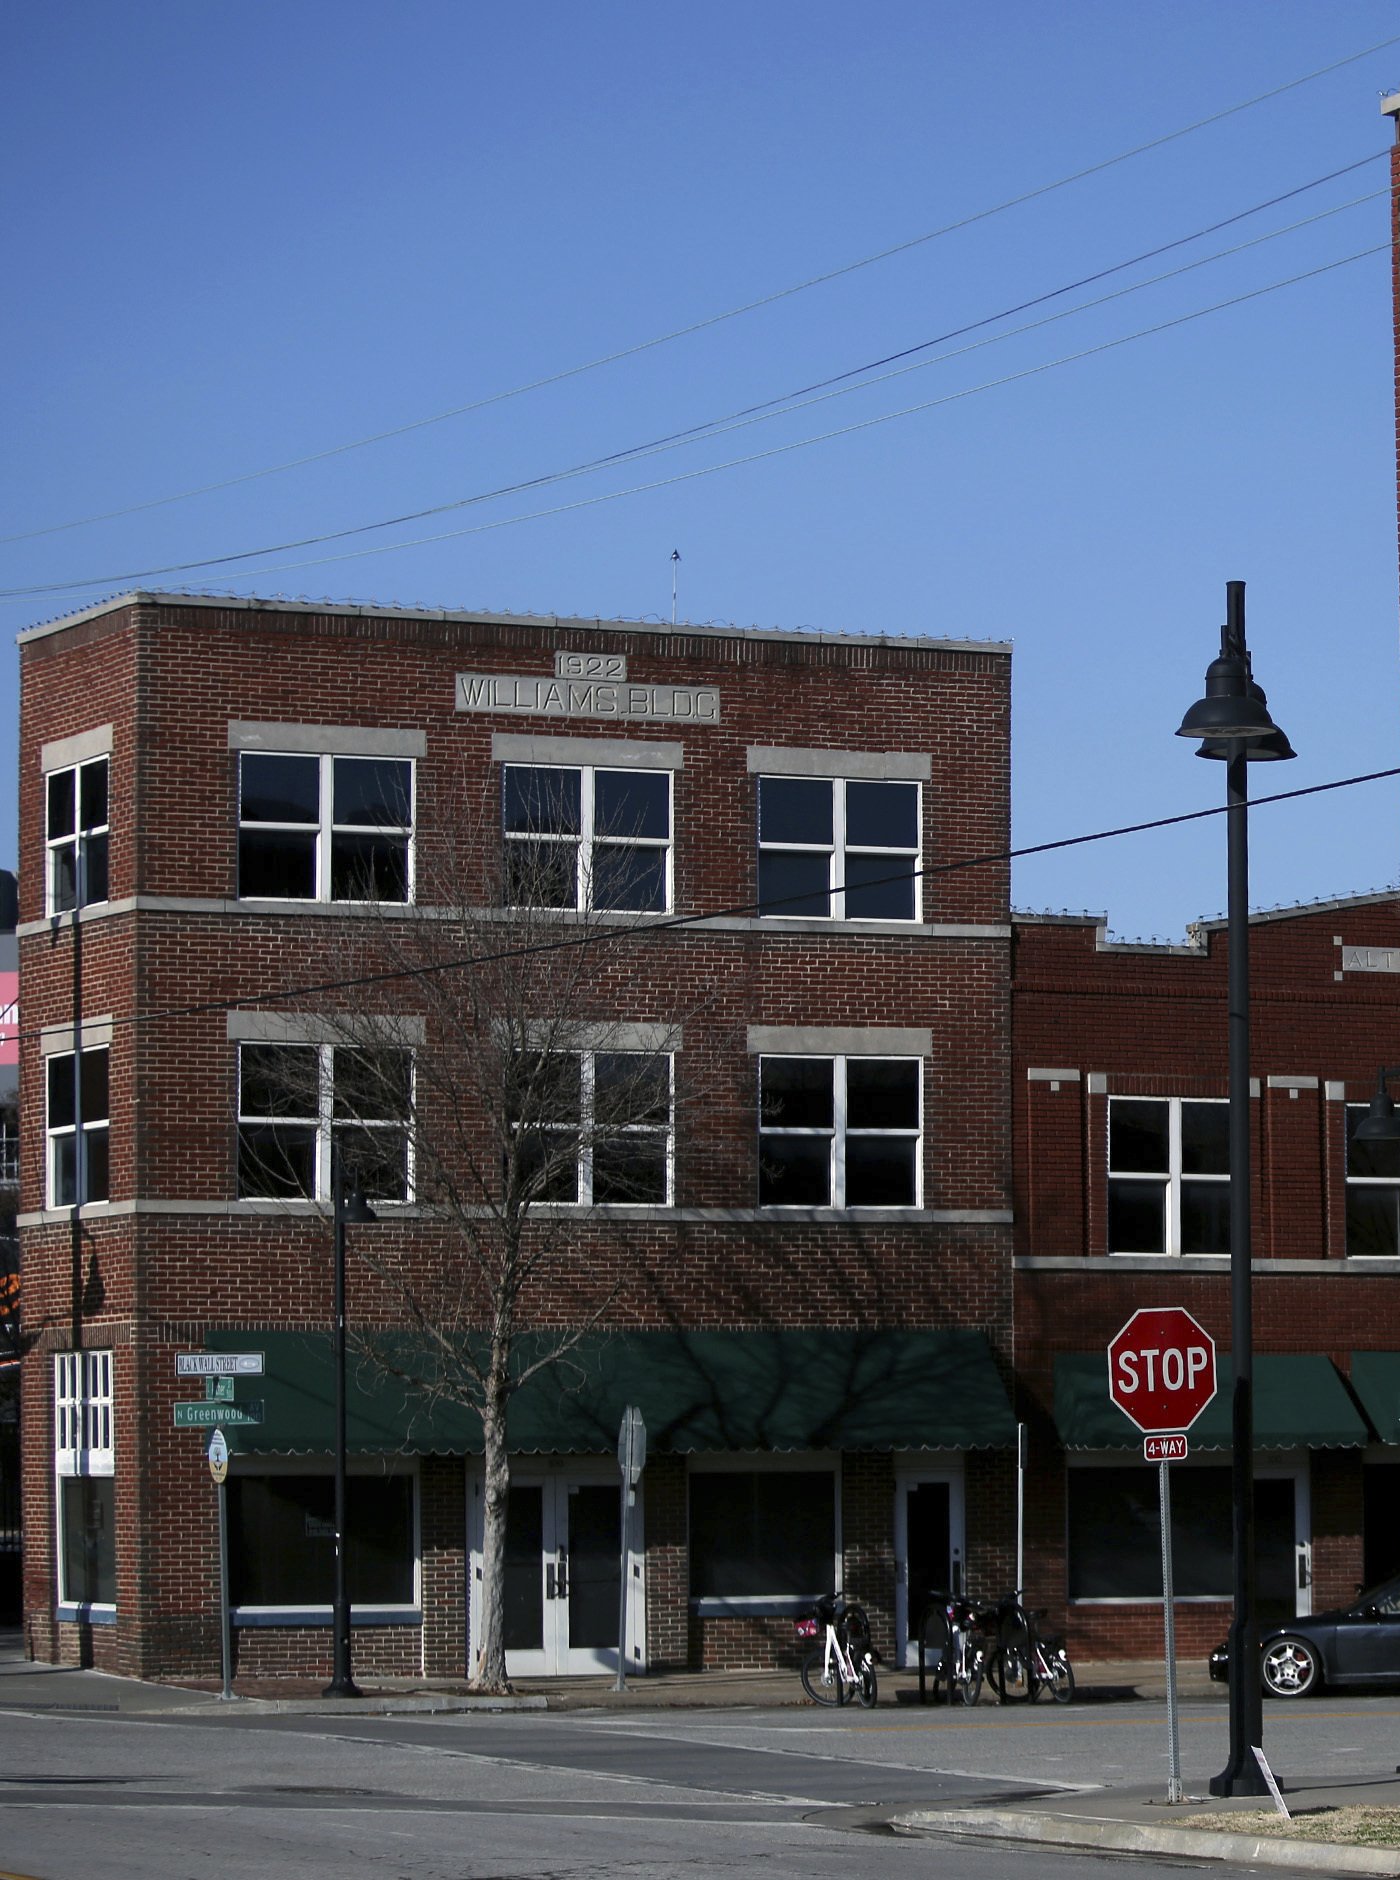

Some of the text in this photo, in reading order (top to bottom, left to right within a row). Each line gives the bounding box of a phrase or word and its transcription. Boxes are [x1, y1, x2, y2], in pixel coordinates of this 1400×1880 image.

[559, 655, 623, 677] 1922
[461, 678, 617, 713] WILLIAMS
[179, 1356, 238, 1372] BLACK WALL STREET
[1118, 1346, 1207, 1393] STOP
[187, 1407, 242, 1420] Greenwood
[1148, 1440, 1183, 1455] 4-WAY
